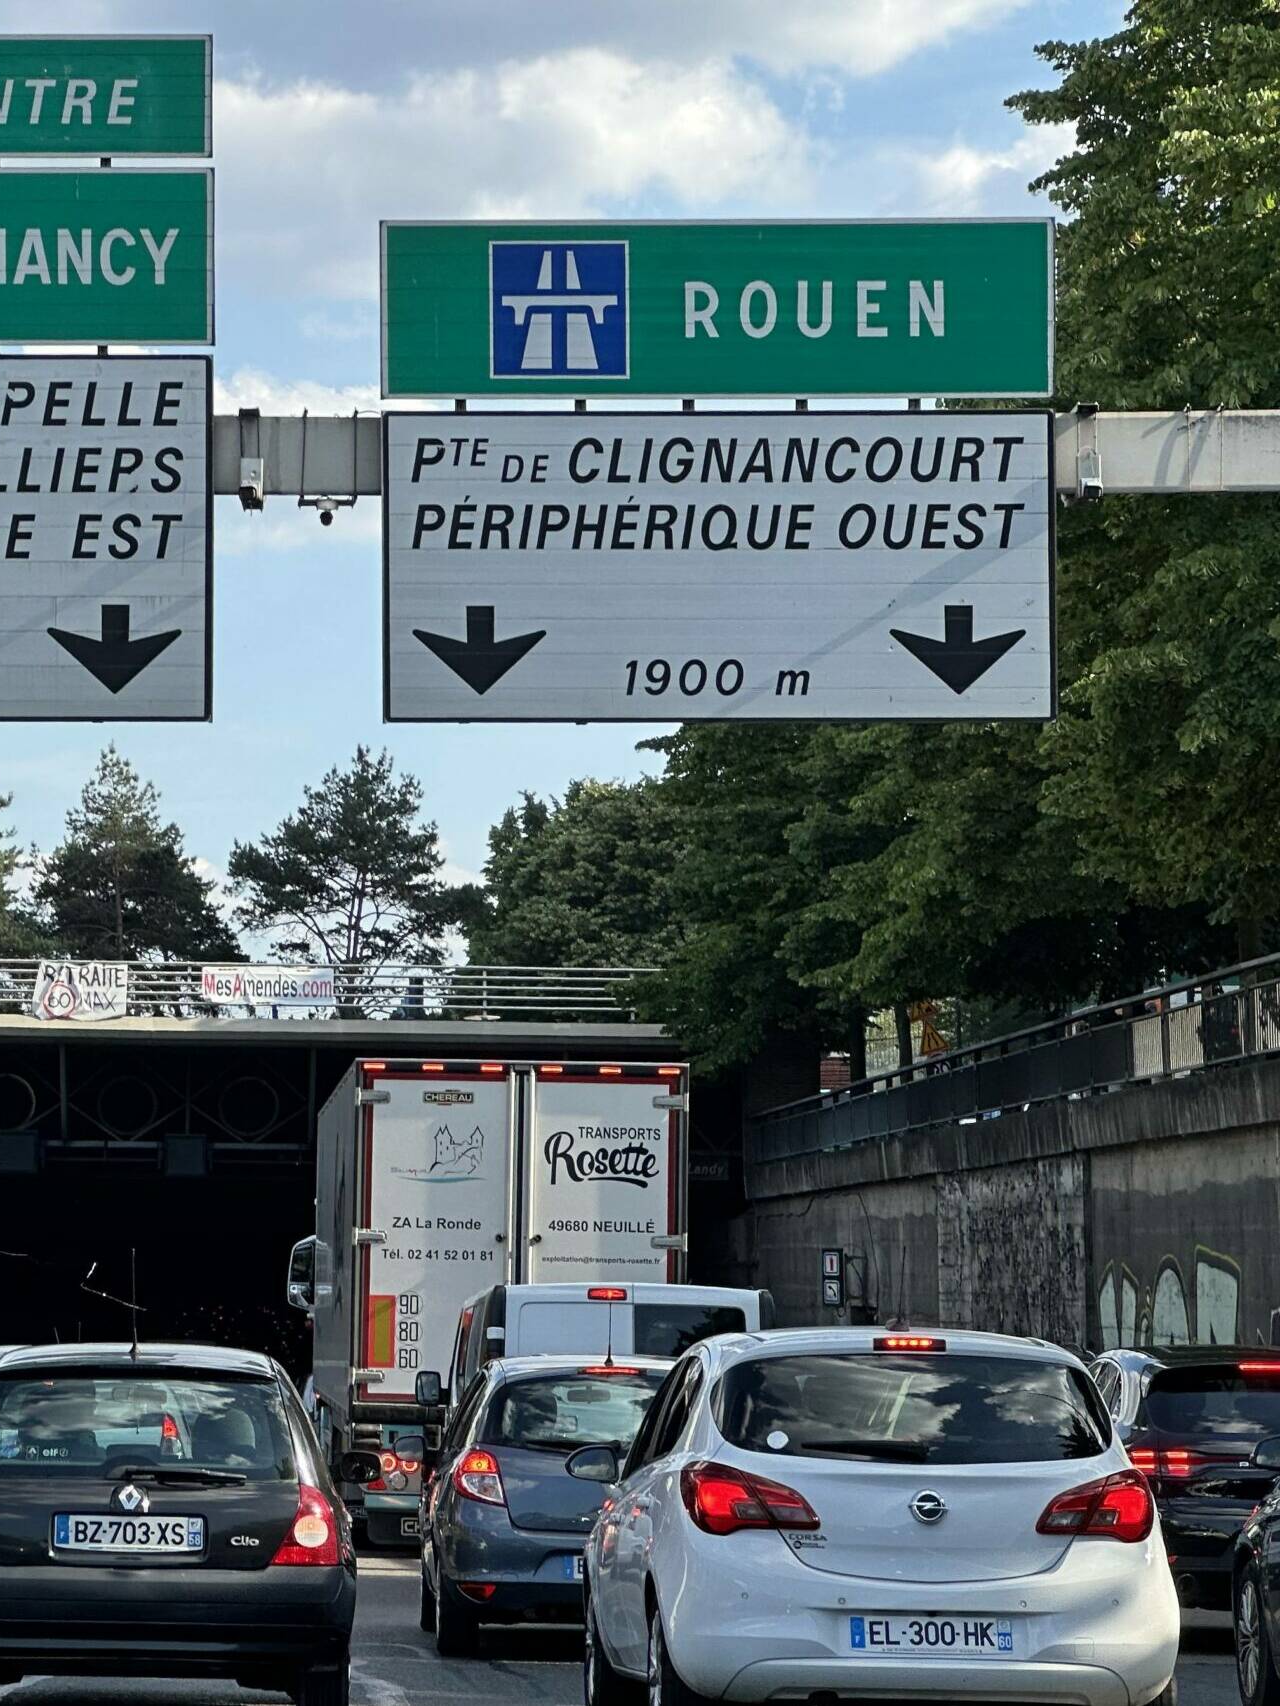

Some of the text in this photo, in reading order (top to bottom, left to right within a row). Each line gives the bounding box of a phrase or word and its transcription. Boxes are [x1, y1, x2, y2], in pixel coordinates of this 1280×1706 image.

[683, 279, 946, 338] ROUEN
[411, 436, 1025, 484] PTE DE CLIGNANCOURT
[411, 495, 1025, 551] PÉRIPHÉRIQUE OUEST
[71, 513, 184, 560] EST
[623, 657, 811, 697] 1900 m
[425, 1093, 473, 1102] CHEREAU
[578, 1126, 661, 1141] TRANSPORTS
[543, 1131, 660, 1185] Rosette
[392, 1217, 482, 1230] ZA La Ronde
[548, 1219, 656, 1234] 49680 NEUILLÉ
[381, 1248, 494, 1261] Tél. 02 41 52 01 81
[400, 1294, 419, 1314] 90
[399, 1321, 418, 1341] 80
[399, 1348, 418, 1368] 60
[74, 1520, 185, 1546] BZ-703-XS
[188, 1533, 201, 1545] 58
[230, 1536, 260, 1547] Clio
[869, 1620, 996, 1647] EL-300-HK
[998, 1637, 1012, 1649] 60
